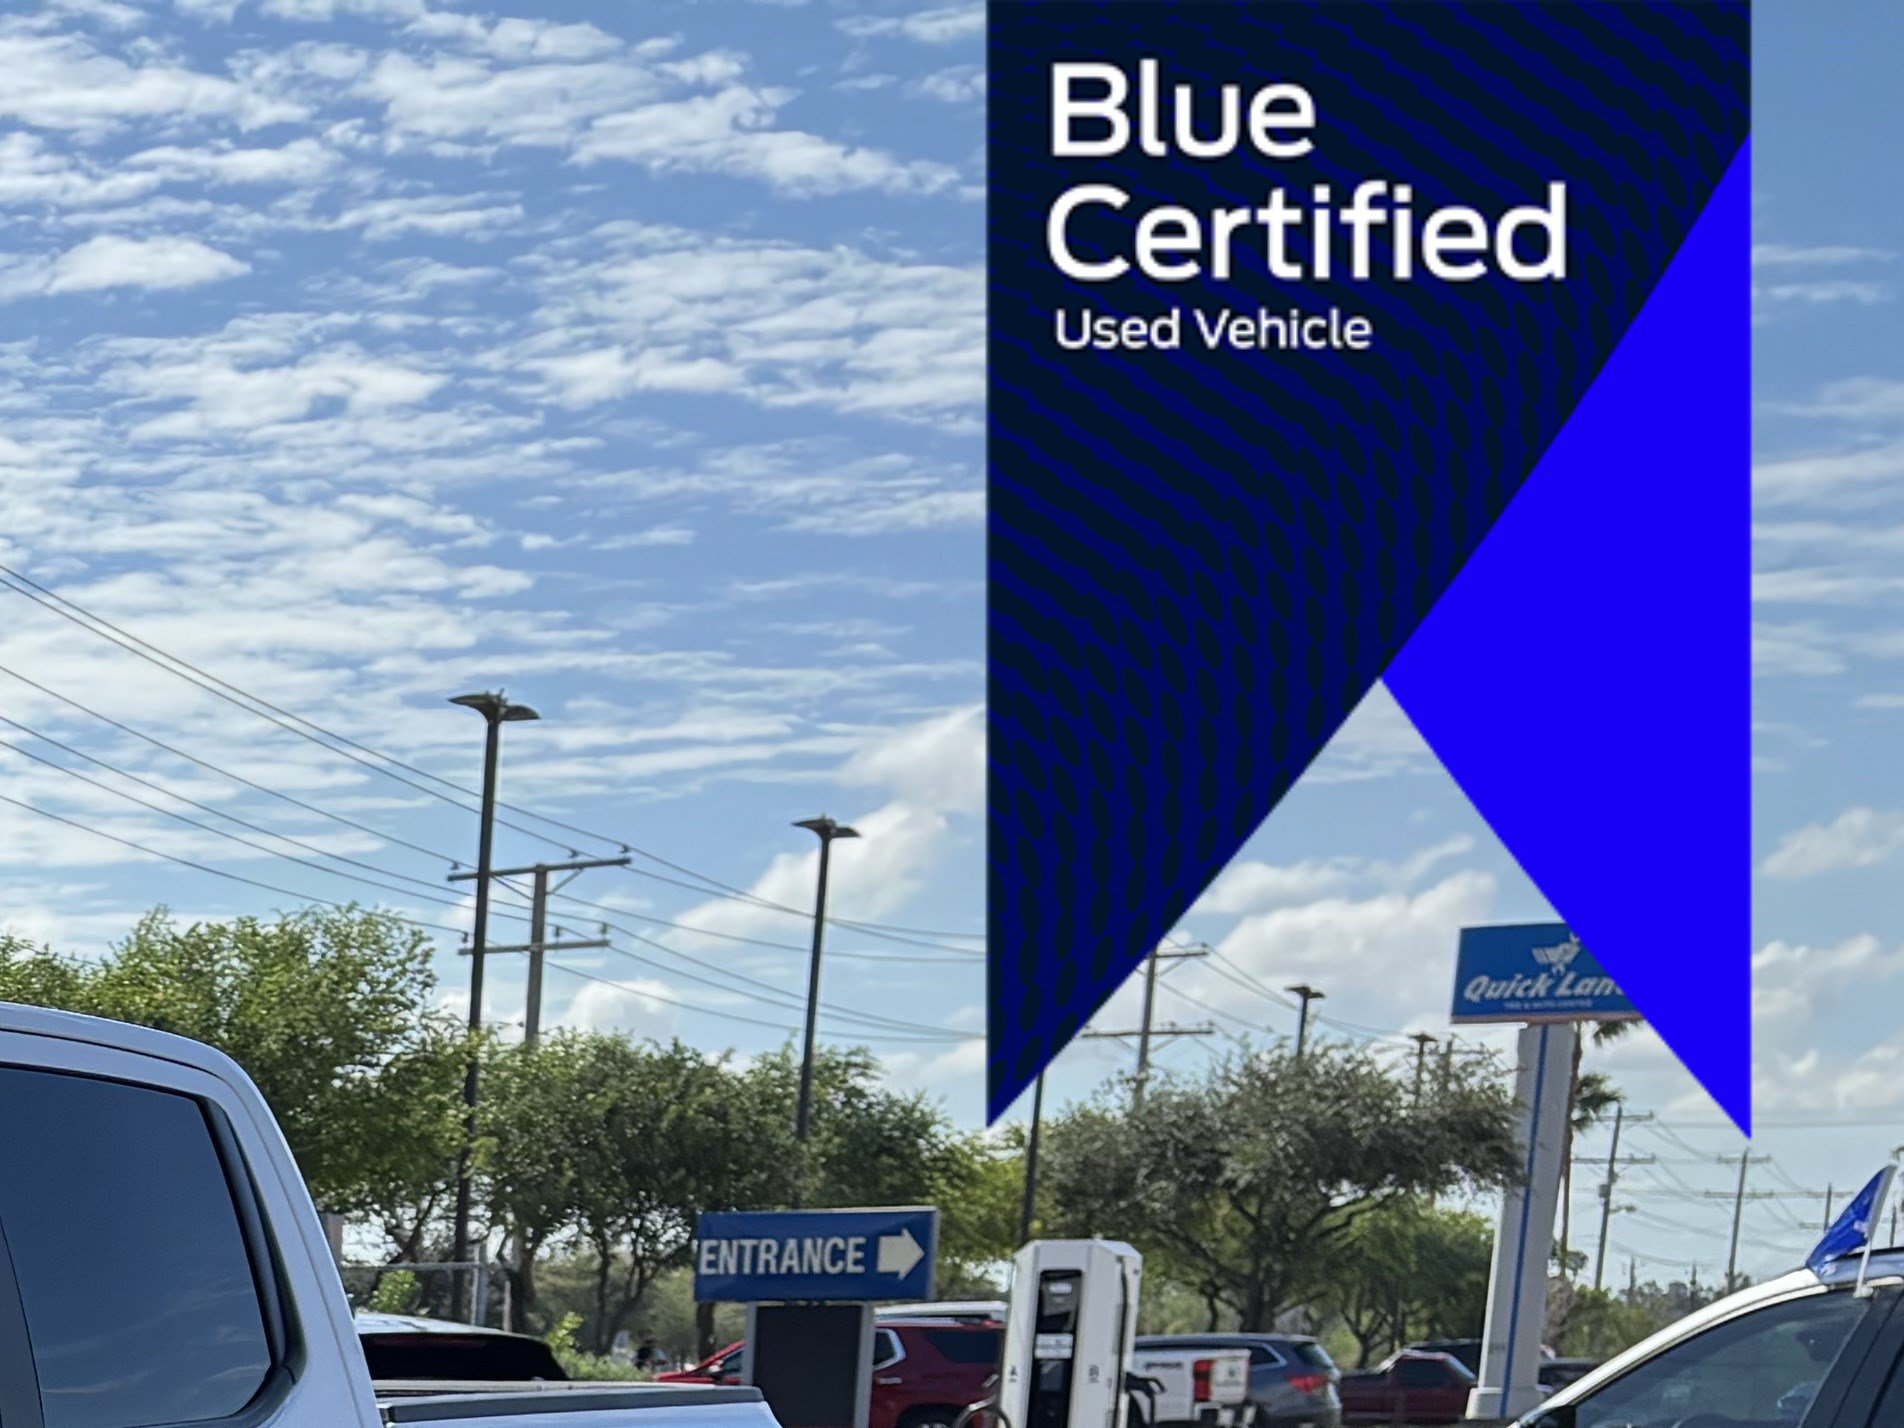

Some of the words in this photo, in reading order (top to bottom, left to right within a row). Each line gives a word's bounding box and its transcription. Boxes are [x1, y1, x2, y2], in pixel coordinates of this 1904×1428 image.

[1464, 972, 1554, 1003] Quick
[1556, 972, 1628, 997] Lan
[698, 1236, 866, 1276] ENTRANCE
